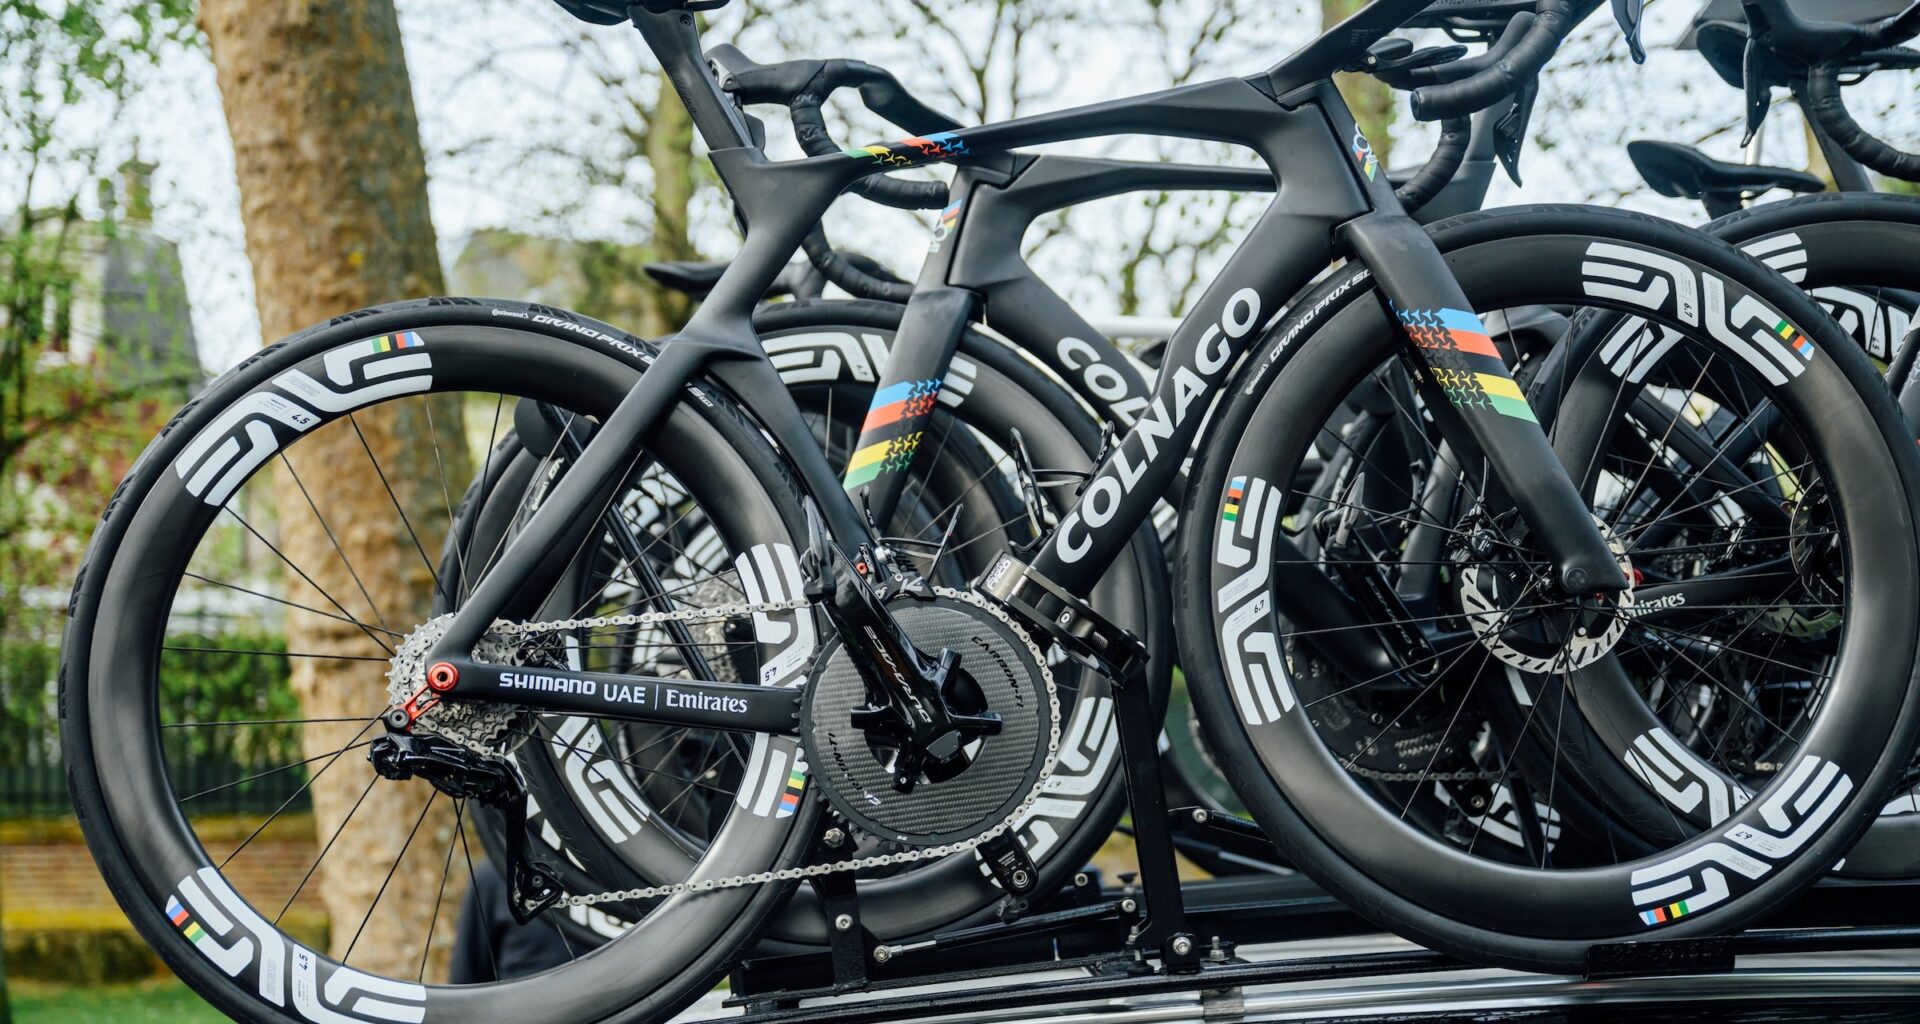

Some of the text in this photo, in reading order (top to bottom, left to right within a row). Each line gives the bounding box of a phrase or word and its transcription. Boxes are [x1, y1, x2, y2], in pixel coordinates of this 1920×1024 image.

[1270, 309, 1315, 363] GRAND
[1314, 280, 1351, 316] PRIX
[1684, 302, 1693, 318] 6.7
[491, 308, 525, 318] Continental
[531, 315, 596, 338] GRAND
[596, 334, 644, 357] PRIX
[1057, 337, 1150, 427] COL
[291, 413, 311, 425] 4.5
[1056, 288, 1261, 563] COLNAGO
[1254, 600, 1264, 614] 6.7
[499, 672, 747, 713] SHIMANO UAE Emirates
[765, 666, 777, 682] 4.5
[863, 626, 931, 723] DURA-ACE
[972, 636, 1024, 708] CARBON-TI
[1734, 830, 1753, 839] 6.7
[299, 953, 309, 971] 4.5
